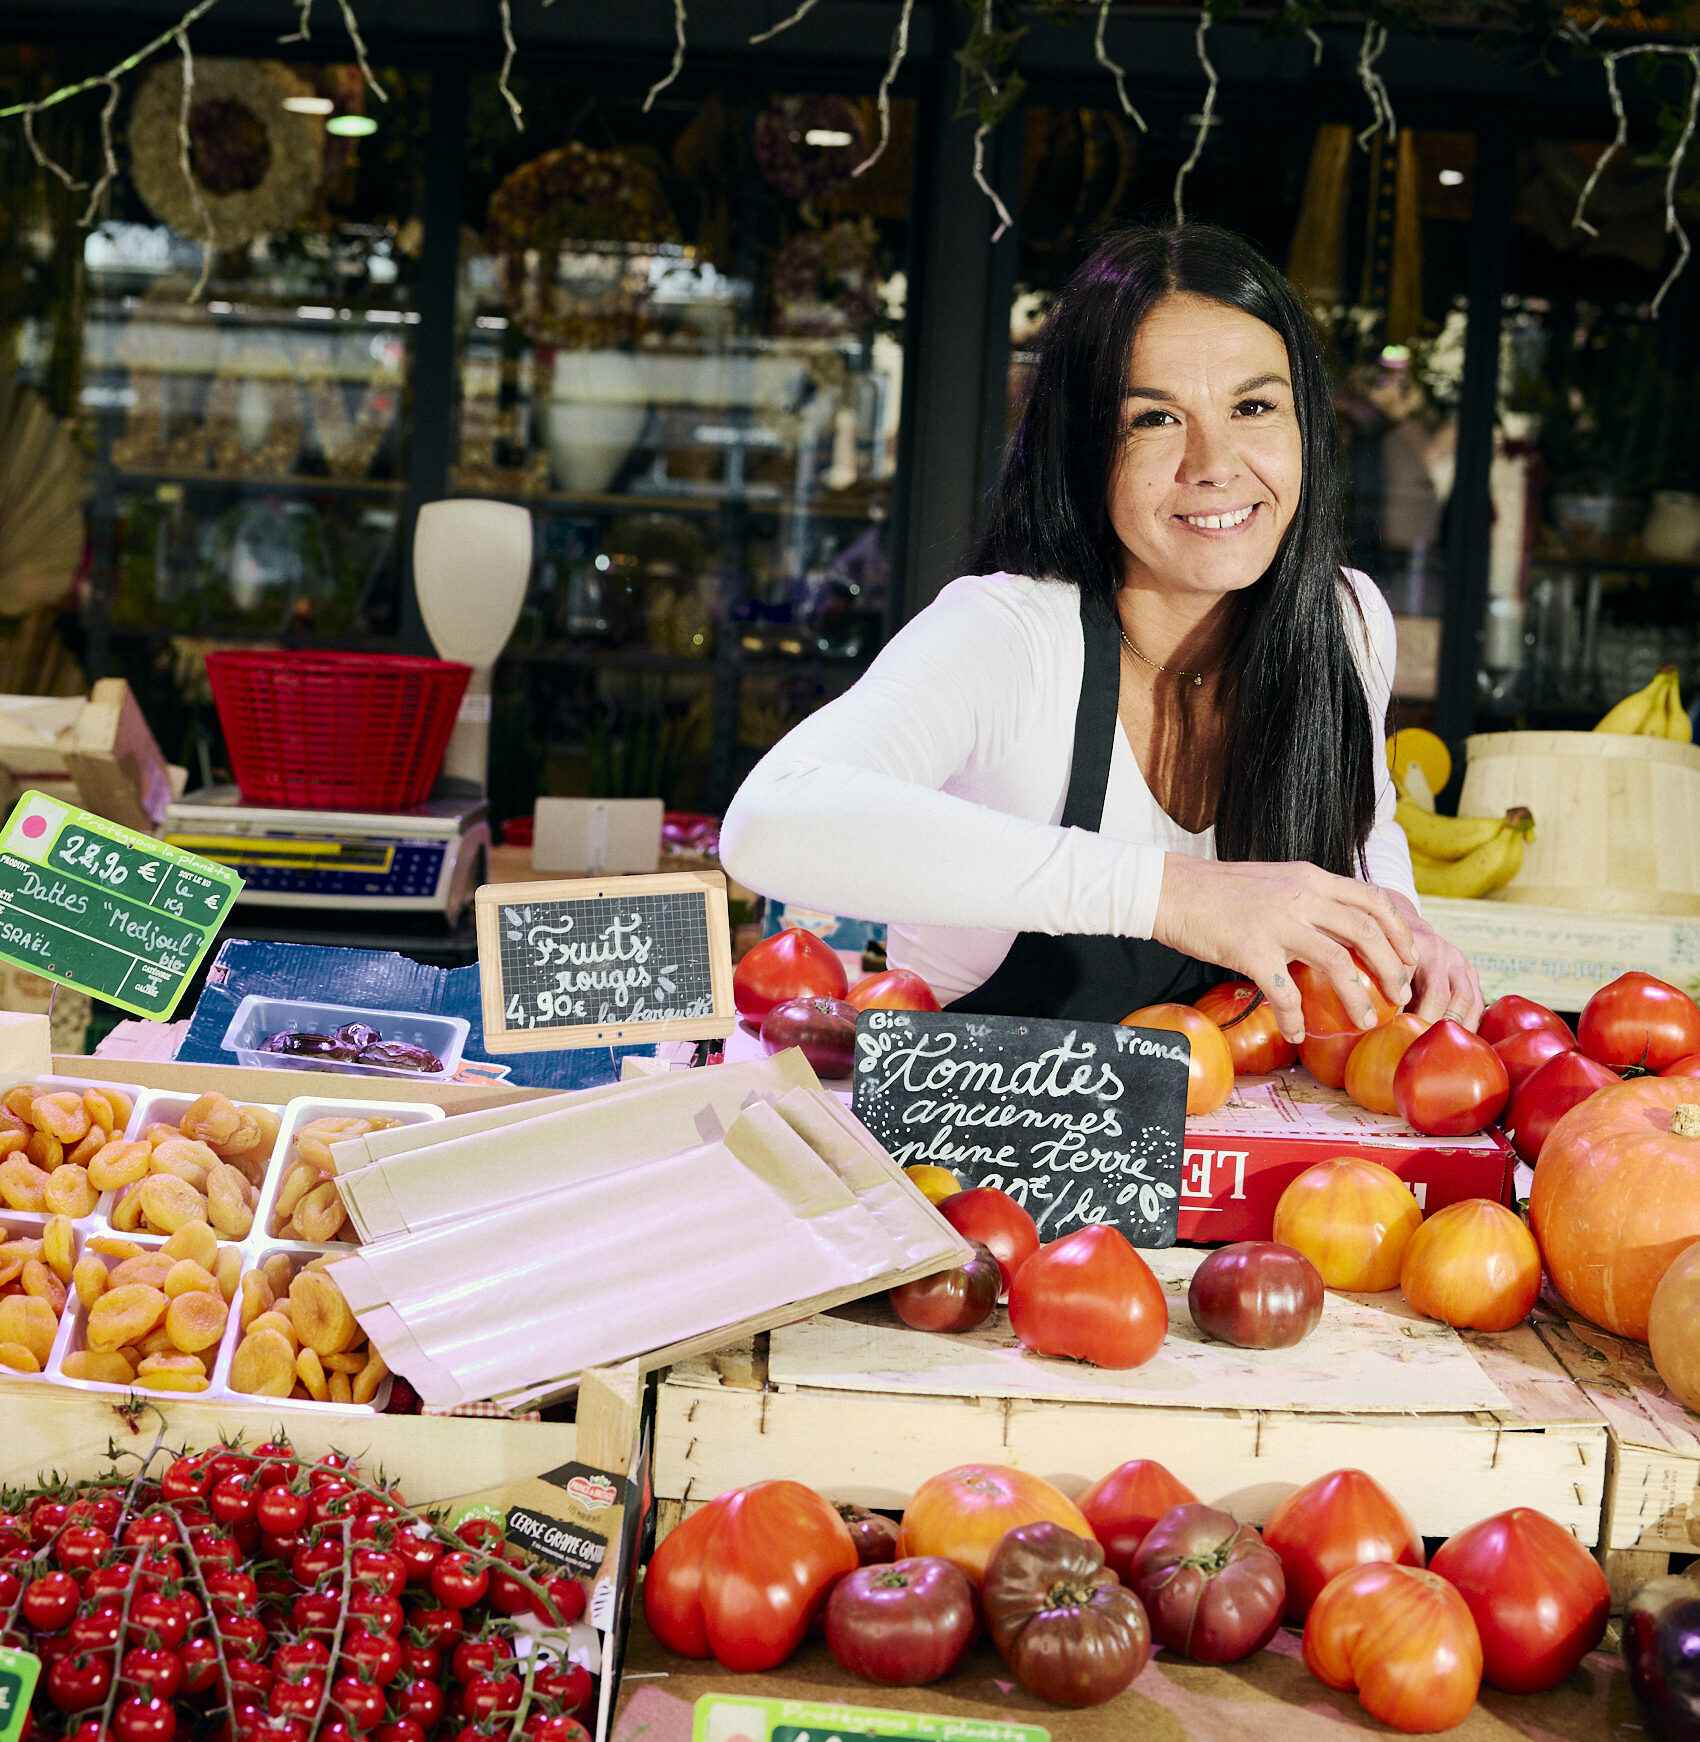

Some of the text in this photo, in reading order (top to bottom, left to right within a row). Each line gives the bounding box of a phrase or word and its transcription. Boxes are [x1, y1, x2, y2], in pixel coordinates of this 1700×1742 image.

[0, 854, 31, 873] PRODUIT
[161, 845, 174, 858] la
[17, 871, 89, 914] Dattes
[0, 921, 51, 957] SRAËL
[527, 913, 652, 966] Fruits
[159, 951, 186, 971] bio
[554, 965, 652, 1008] rouges
[869, 1011, 910, 1030] Bio
[902, 1095, 1122, 1137] anciennes
[891, 1125, 1019, 1168] pleine
[510, 1511, 547, 1539] CERISE
